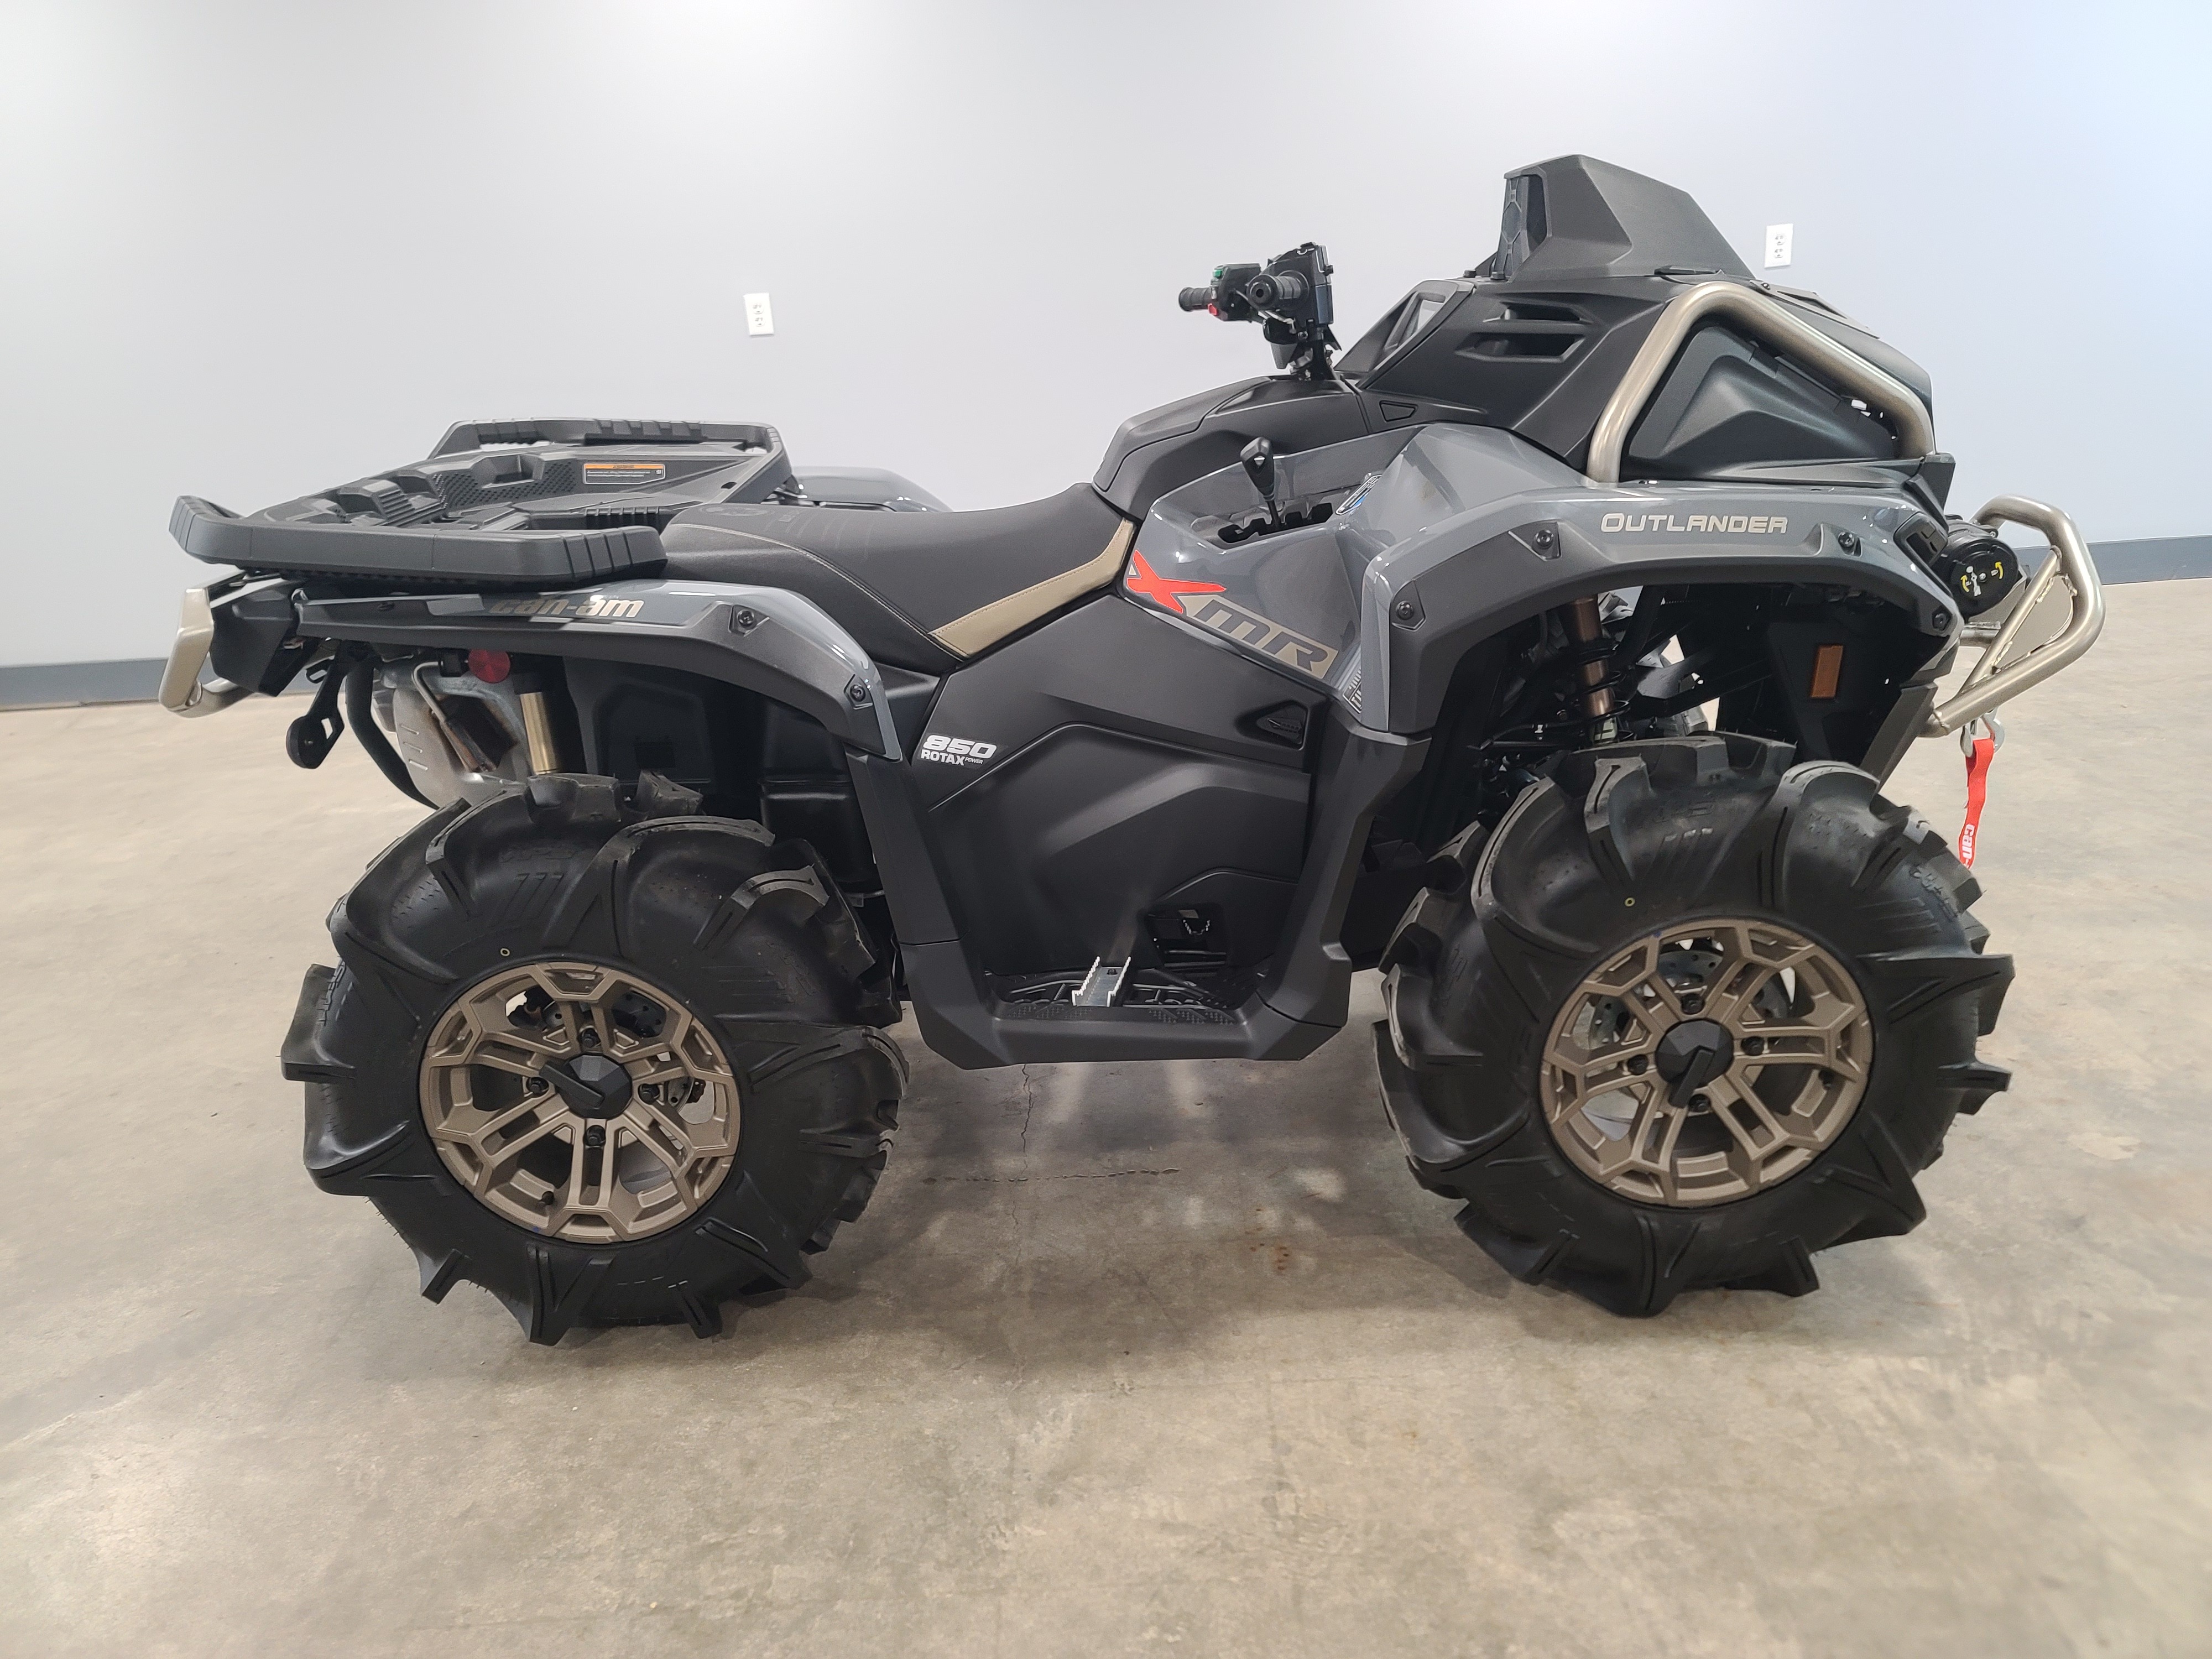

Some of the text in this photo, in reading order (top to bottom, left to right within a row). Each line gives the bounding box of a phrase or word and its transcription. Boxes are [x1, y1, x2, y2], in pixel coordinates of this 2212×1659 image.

[1600, 513, 1788, 534] OUTLANDER
[489, 598, 644, 618] can-am
[923, 734, 997, 759] 850
[921, 749, 966, 766] ROTAX
[1961, 823, 1975, 869] can-
